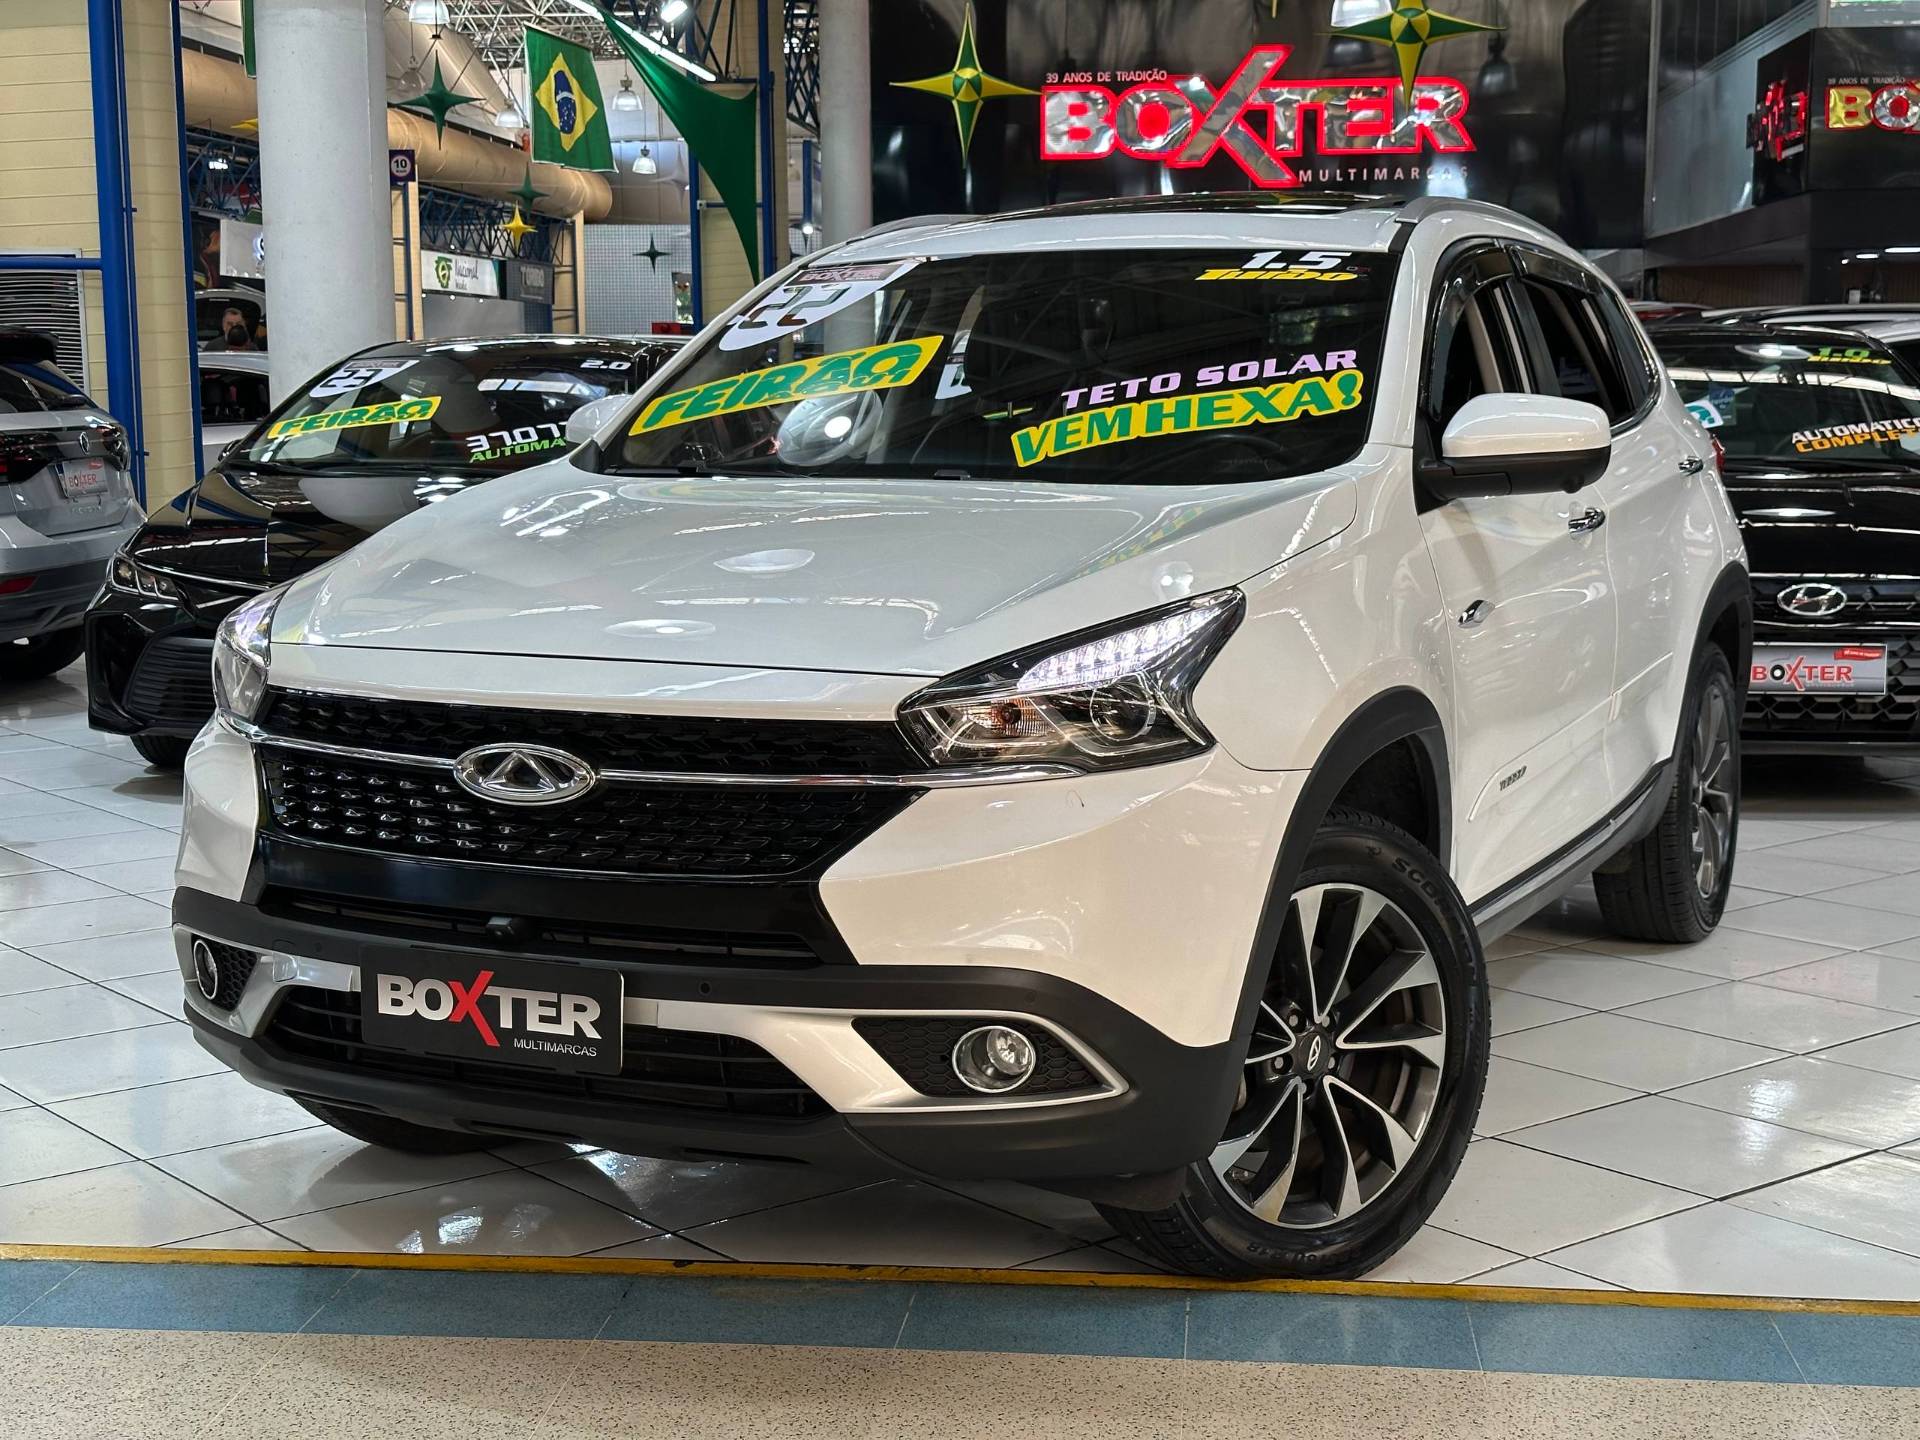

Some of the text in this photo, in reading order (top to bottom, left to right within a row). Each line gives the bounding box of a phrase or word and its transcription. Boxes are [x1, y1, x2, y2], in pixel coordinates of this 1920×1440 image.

[1046, 68, 1167, 84] 39 ANOS DE TRADIÇÃO
[1040, 44, 1476, 188] BOXTER
[393, 159, 407, 168] 10
[1298, 166, 1469, 182] MULTIMARCAS
[1242, 251, 1352, 269] 1.5
[580, 360, 631, 370] 2.0
[319, 368, 384, 389] 23
[1061, 350, 1357, 410] TETO SOLAR
[1015, 373, 1360, 463] VEM HEXA!
[469, 437, 567, 463] AUTOMA
[1796, 427, 1920, 453] COMPLET
[1751, 656, 1854, 691] BOXTER
[377, 970, 602, 1047] BOXTER
[514, 1038, 597, 1057] MULTIMARCAS
